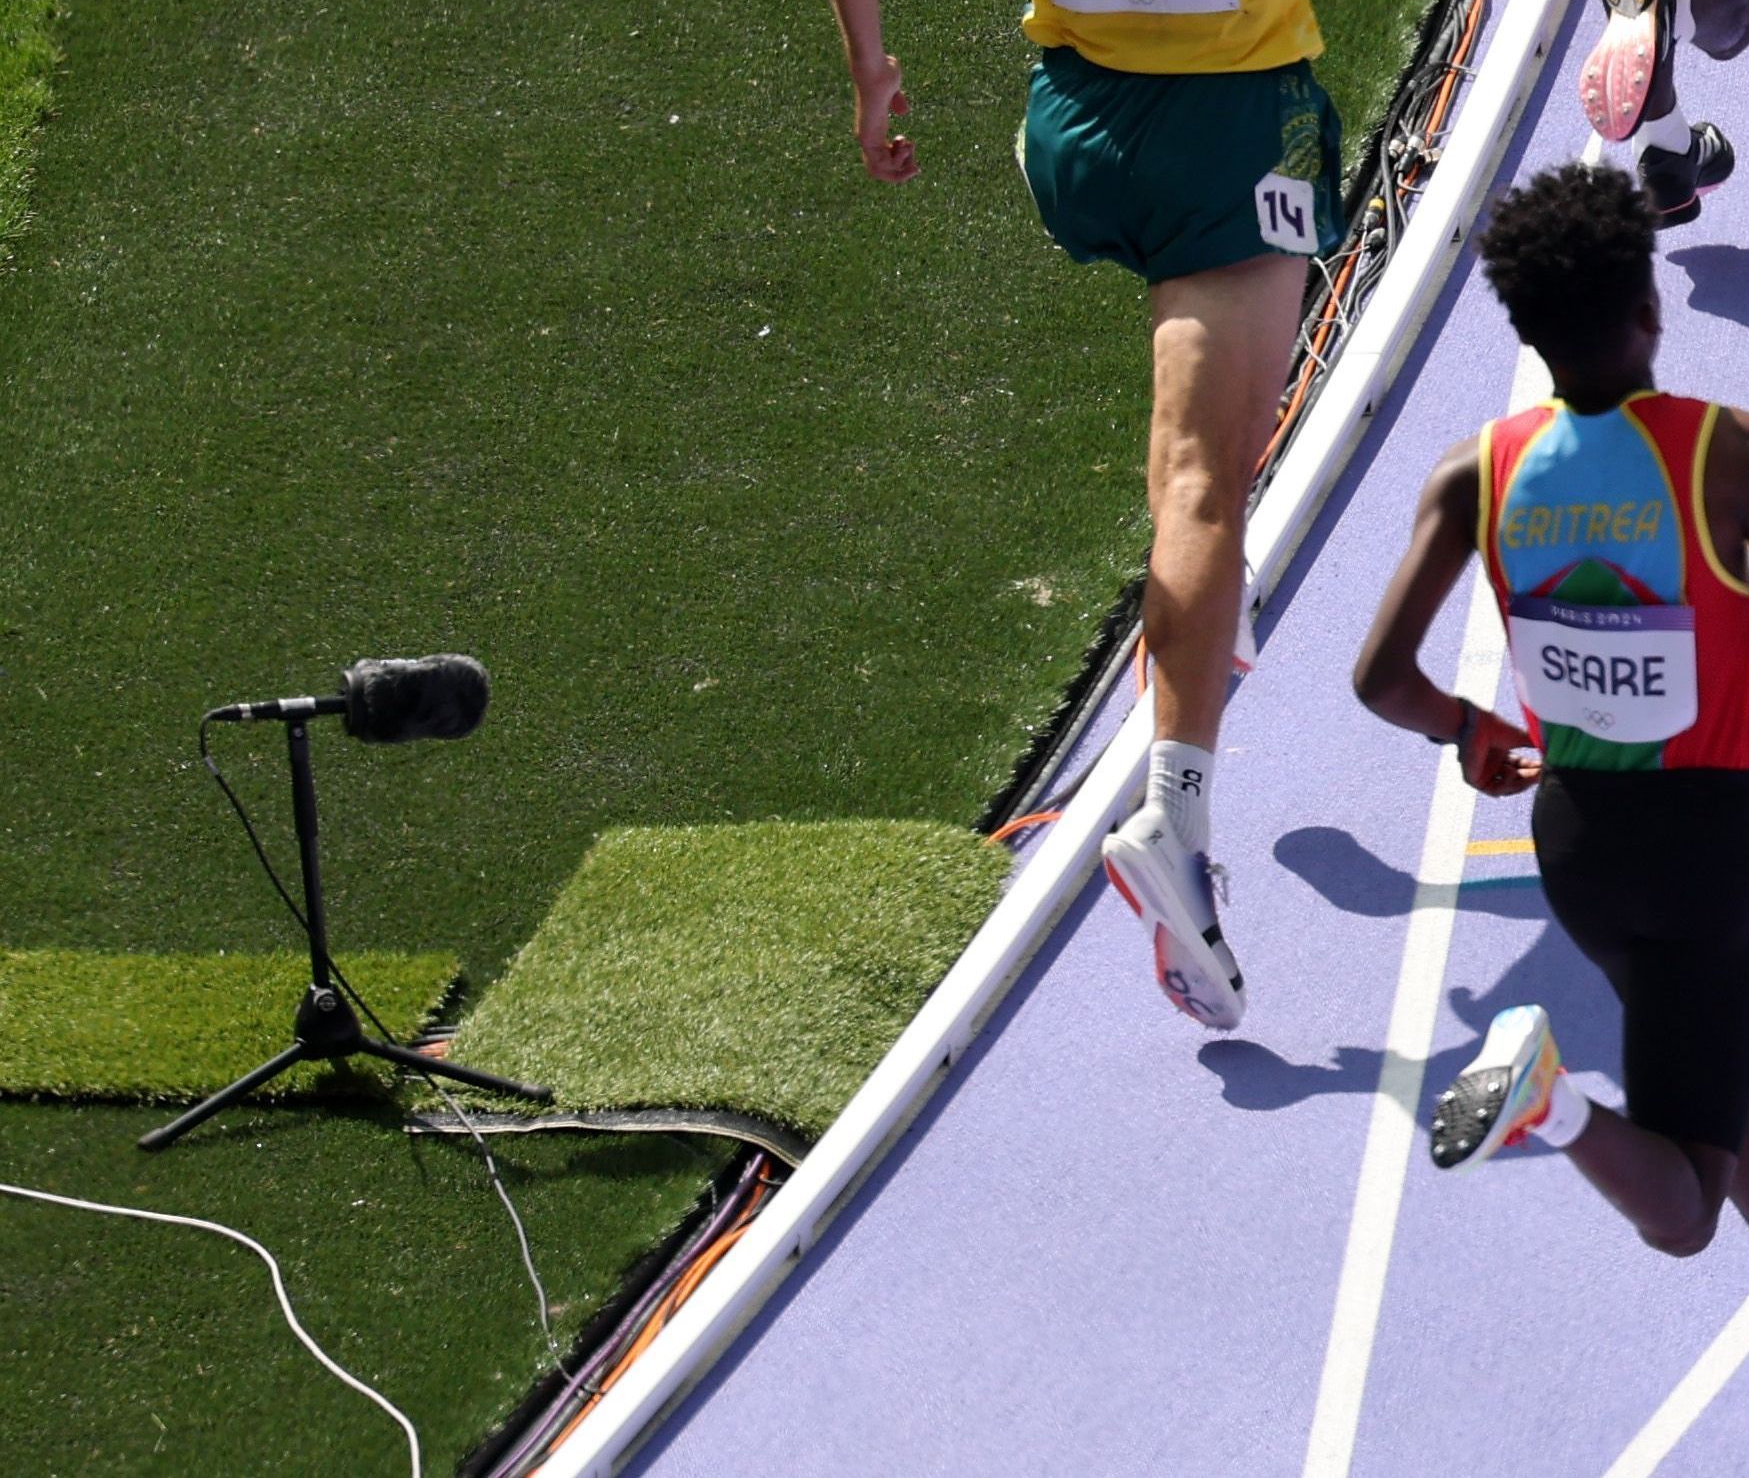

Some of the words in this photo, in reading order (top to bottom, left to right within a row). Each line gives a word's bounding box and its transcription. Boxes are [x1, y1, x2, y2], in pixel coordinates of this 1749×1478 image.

[1263, 190, 1305, 238] 14
[1503, 500, 1663, 550] ERITREA
[1541, 644, 1666, 697] SEARE
